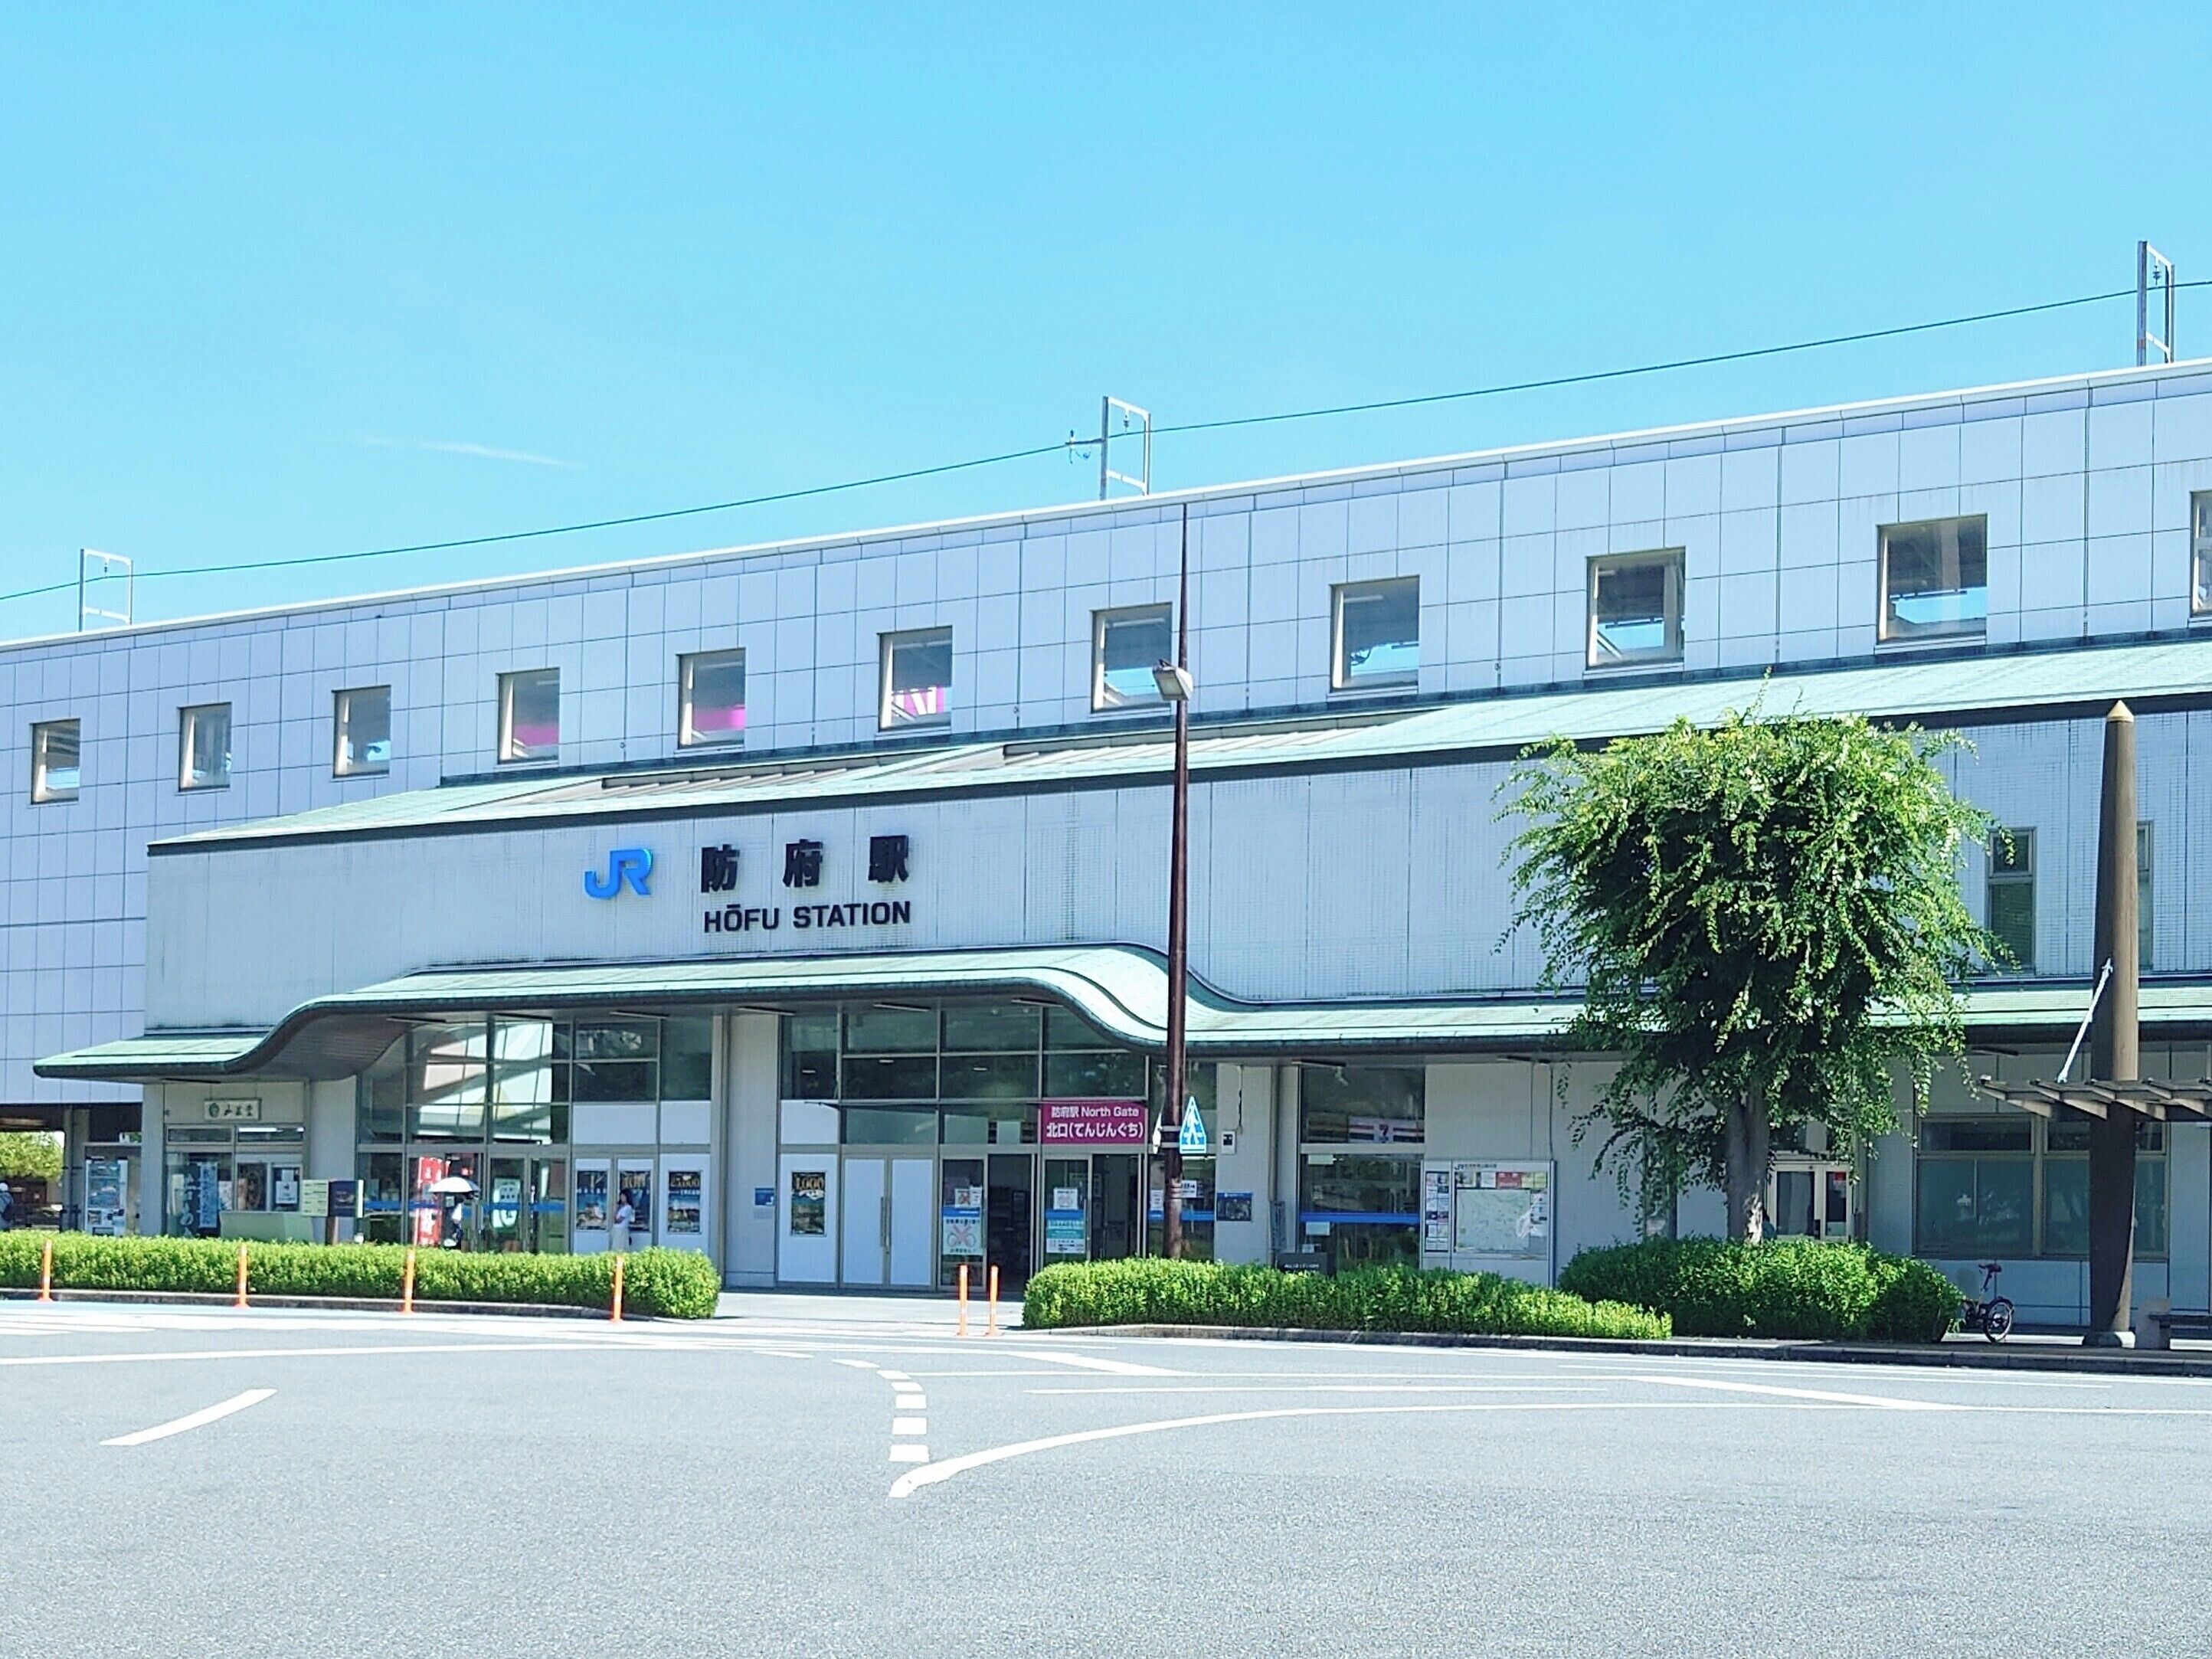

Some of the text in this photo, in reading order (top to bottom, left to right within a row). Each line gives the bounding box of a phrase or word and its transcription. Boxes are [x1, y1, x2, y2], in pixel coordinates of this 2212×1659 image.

[584, 849, 653, 899] JR
[701, 835, 908, 893] 防府駅
[704, 900, 911, 933] HŌFU STATION
[1081, 1106, 1111, 1117] North
[1113, 1107, 1139, 1117] Gate
[1046, 1122, 1144, 1138] 北口(てんじんぐち)
